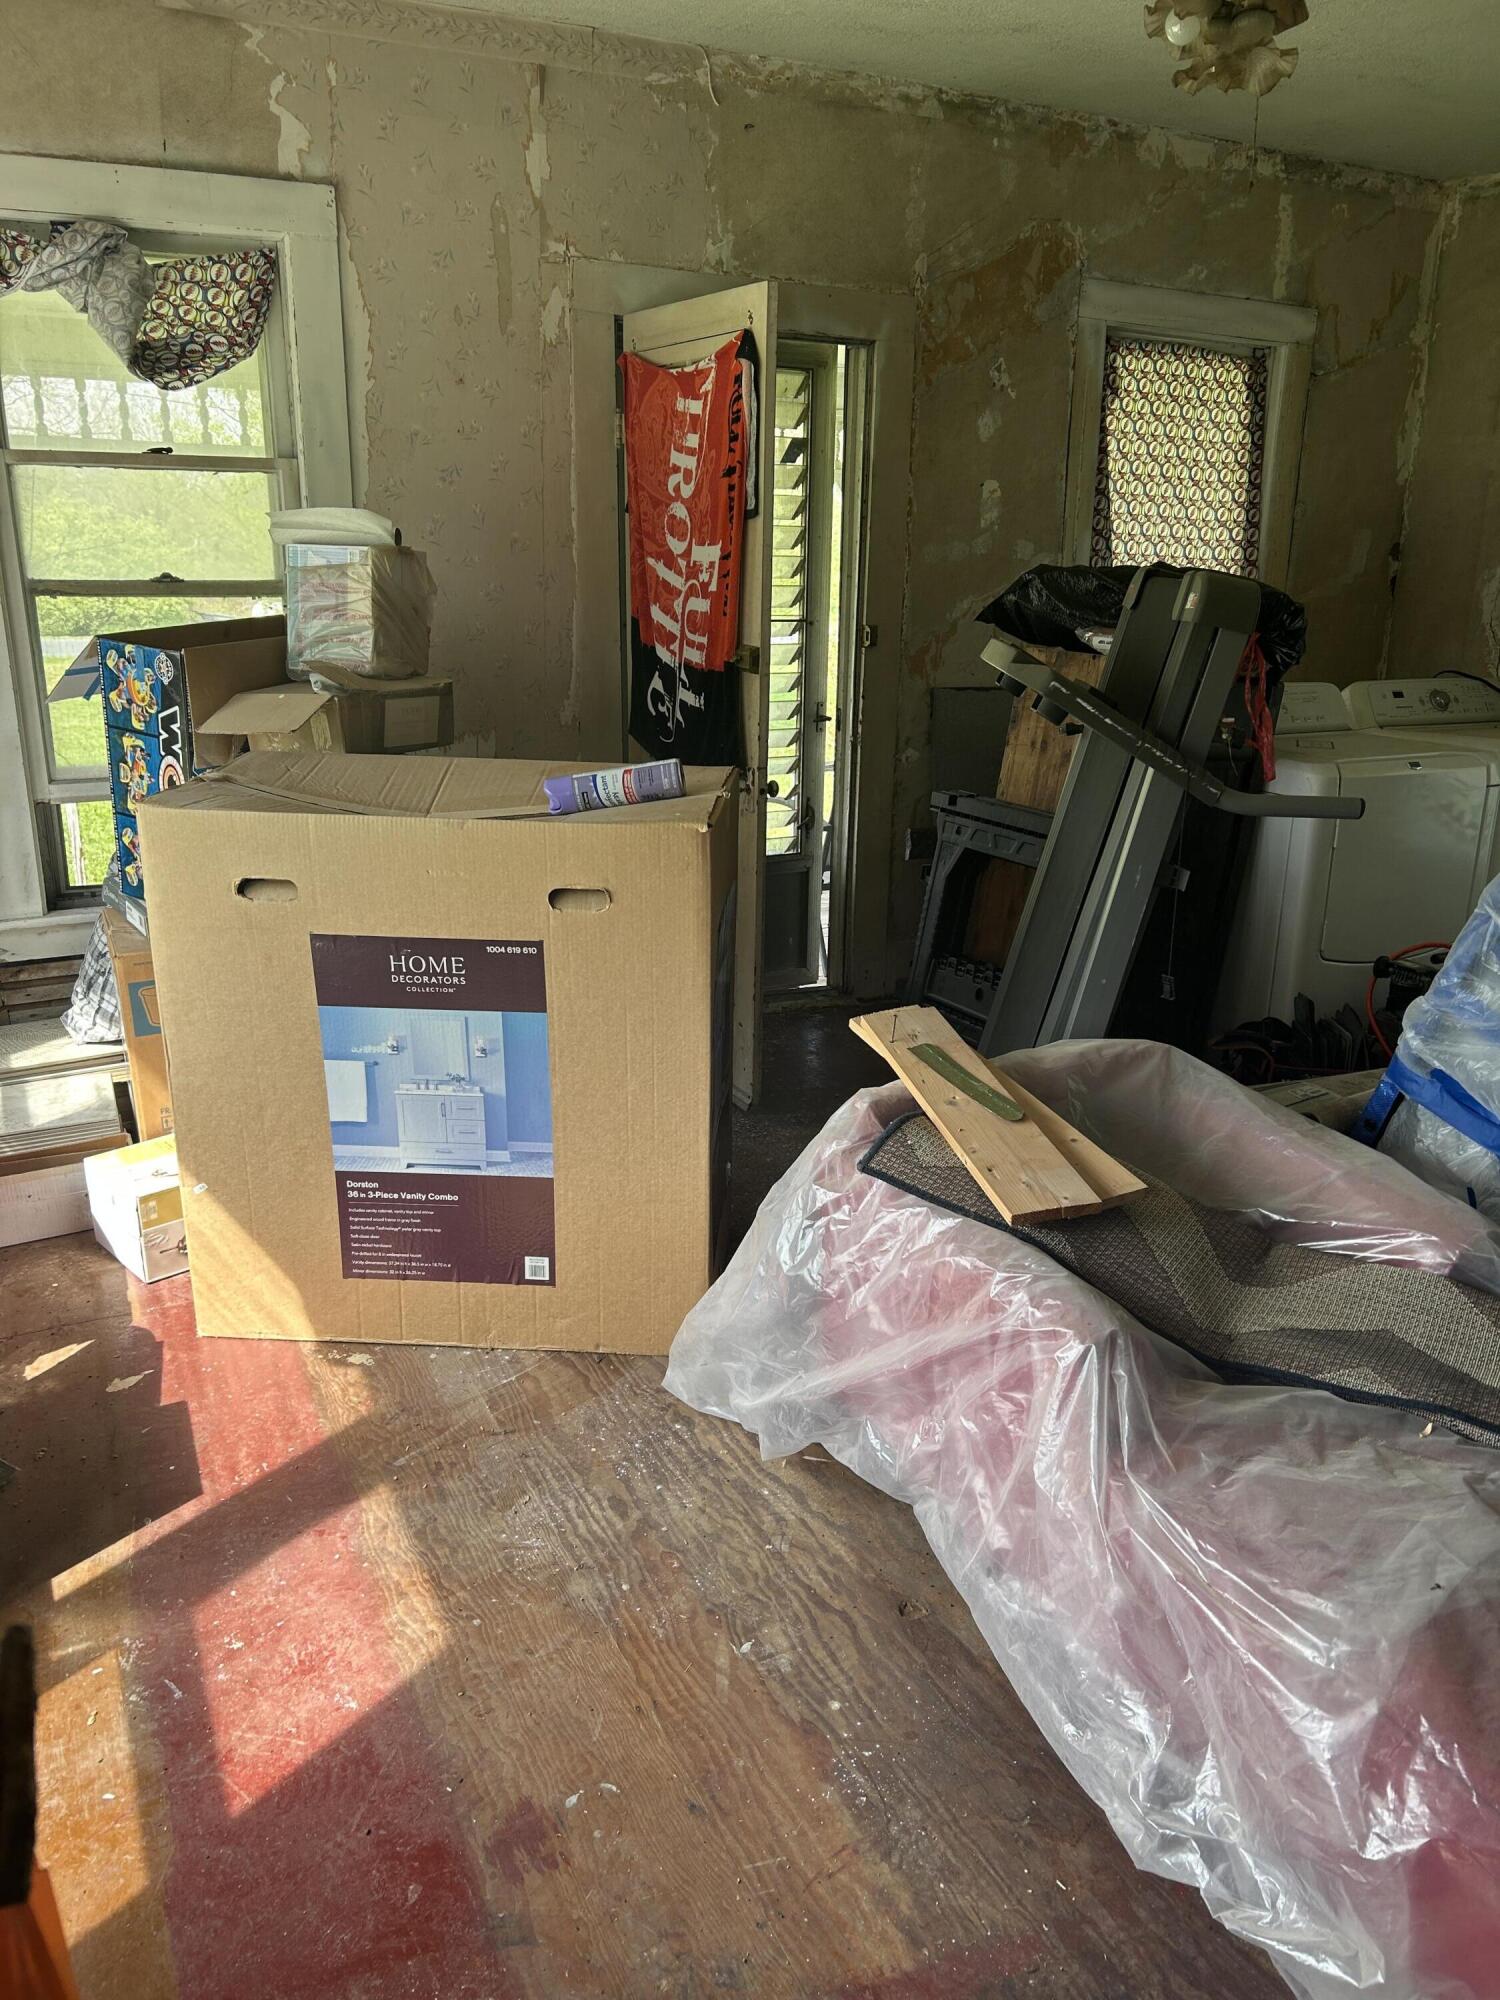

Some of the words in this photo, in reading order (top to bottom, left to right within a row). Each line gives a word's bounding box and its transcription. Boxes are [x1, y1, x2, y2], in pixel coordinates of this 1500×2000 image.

[677, 533, 723, 728] FULL
[506, 946, 521, 954] 619
[389, 955, 466, 974] HOME
[391, 975, 466, 985] DECORATORS
[346, 1180, 379, 1188] Dorston
[347, 1190, 359, 1198] 36
[367, 1191, 399, 1199] 3-Piece
[400, 1192, 427, 1201] Vanity
[428, 1193, 459, 1201] Combo
